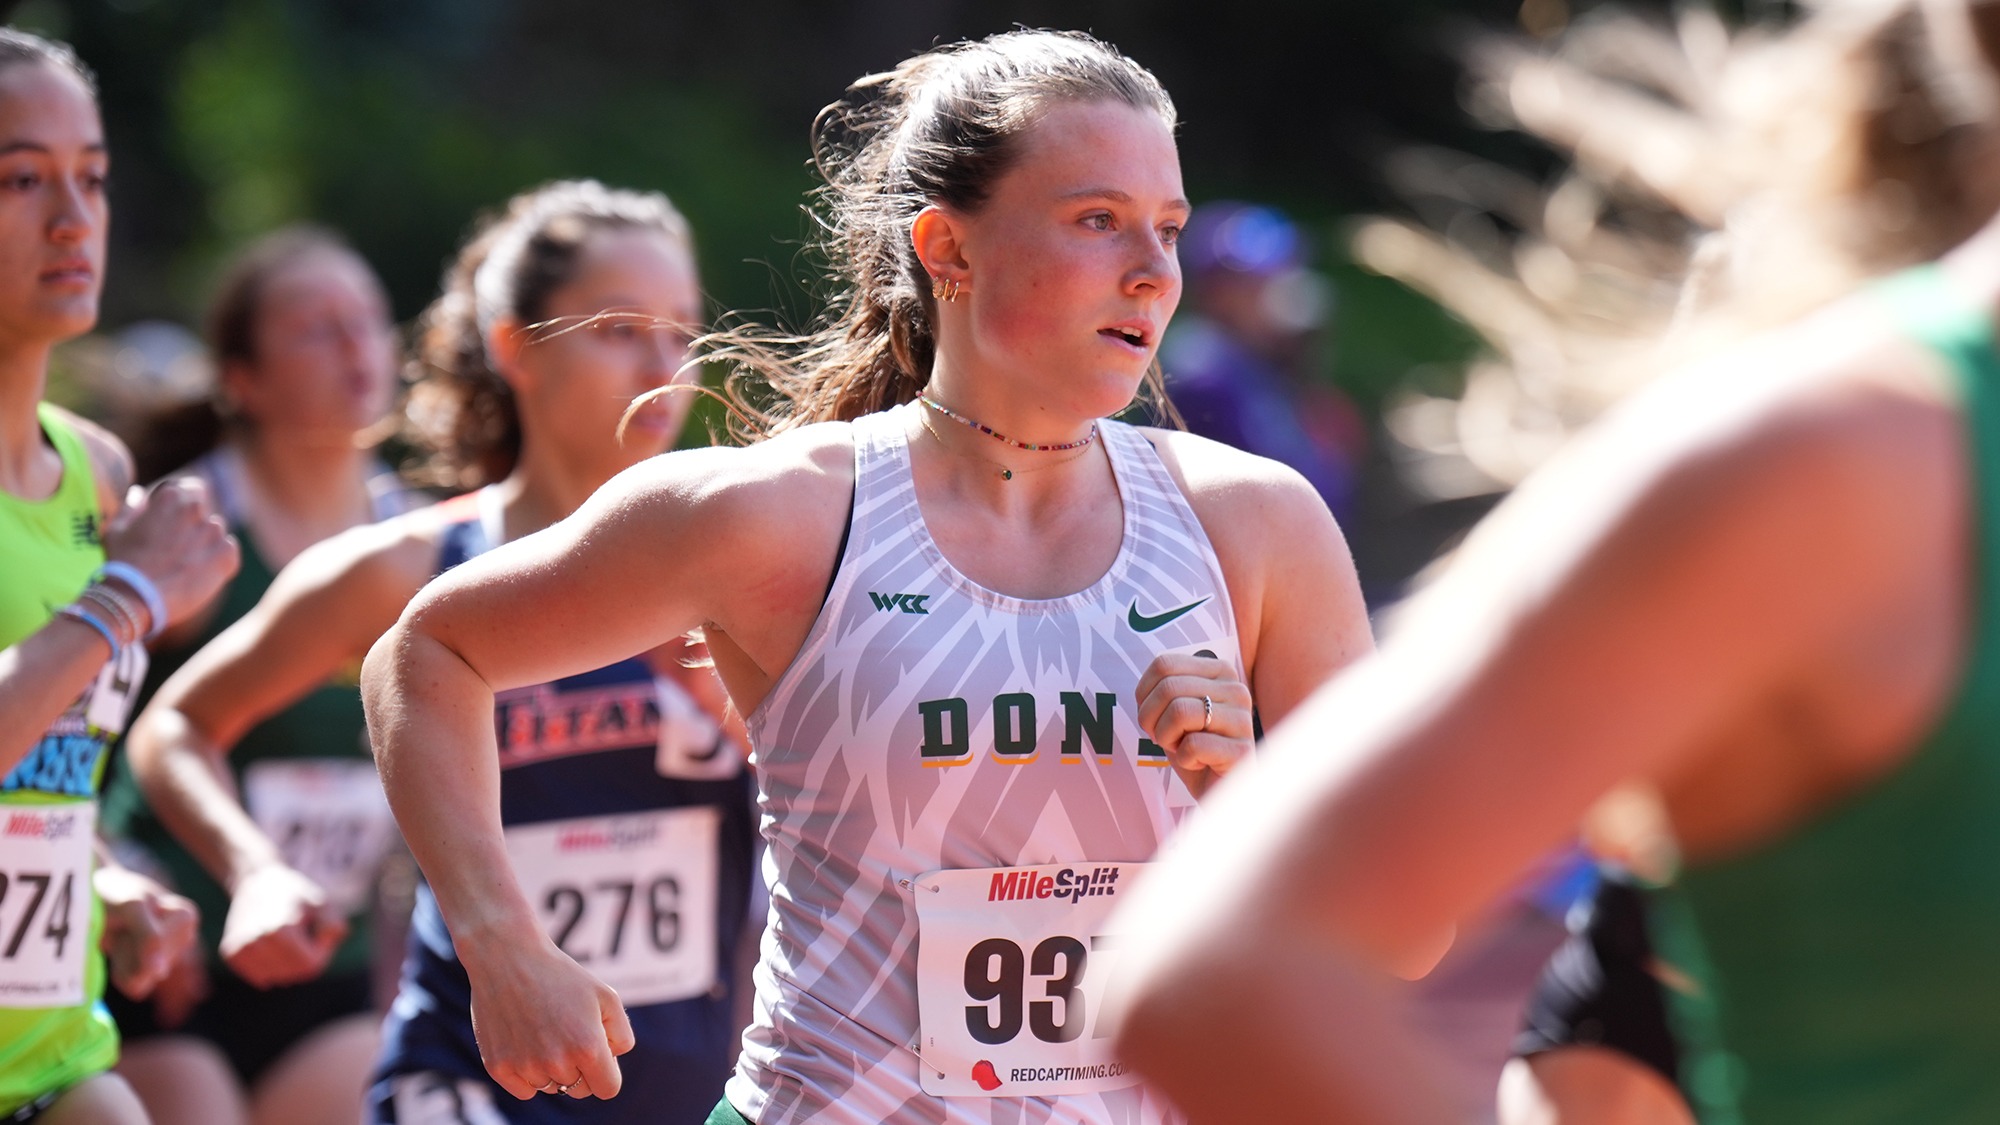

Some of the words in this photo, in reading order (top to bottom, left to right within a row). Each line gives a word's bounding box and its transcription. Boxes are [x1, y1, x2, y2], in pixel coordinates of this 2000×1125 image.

[868, 591, 930, 615] WCC
[918, 691, 1168, 759] DON
[988, 867, 1119, 904] MileSplit
[546, 875, 681, 962] 276
